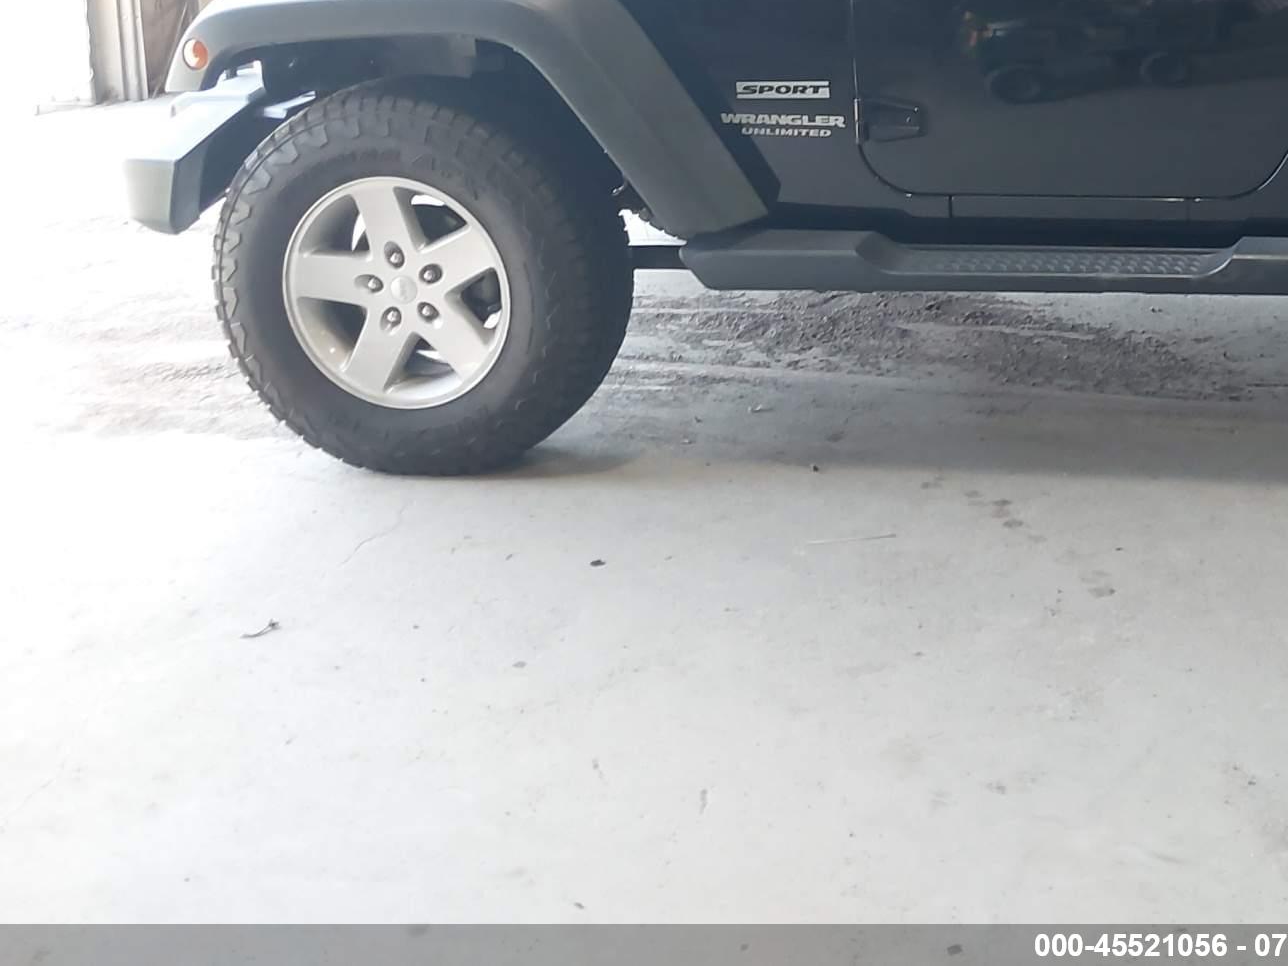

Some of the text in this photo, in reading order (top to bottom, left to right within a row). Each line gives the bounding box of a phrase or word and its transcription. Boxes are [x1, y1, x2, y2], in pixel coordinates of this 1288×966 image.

[737, 84, 829, 96] SPORT
[720, 113, 846, 128] WRANGLER
[741, 127, 832, 137] UNLIMITED
